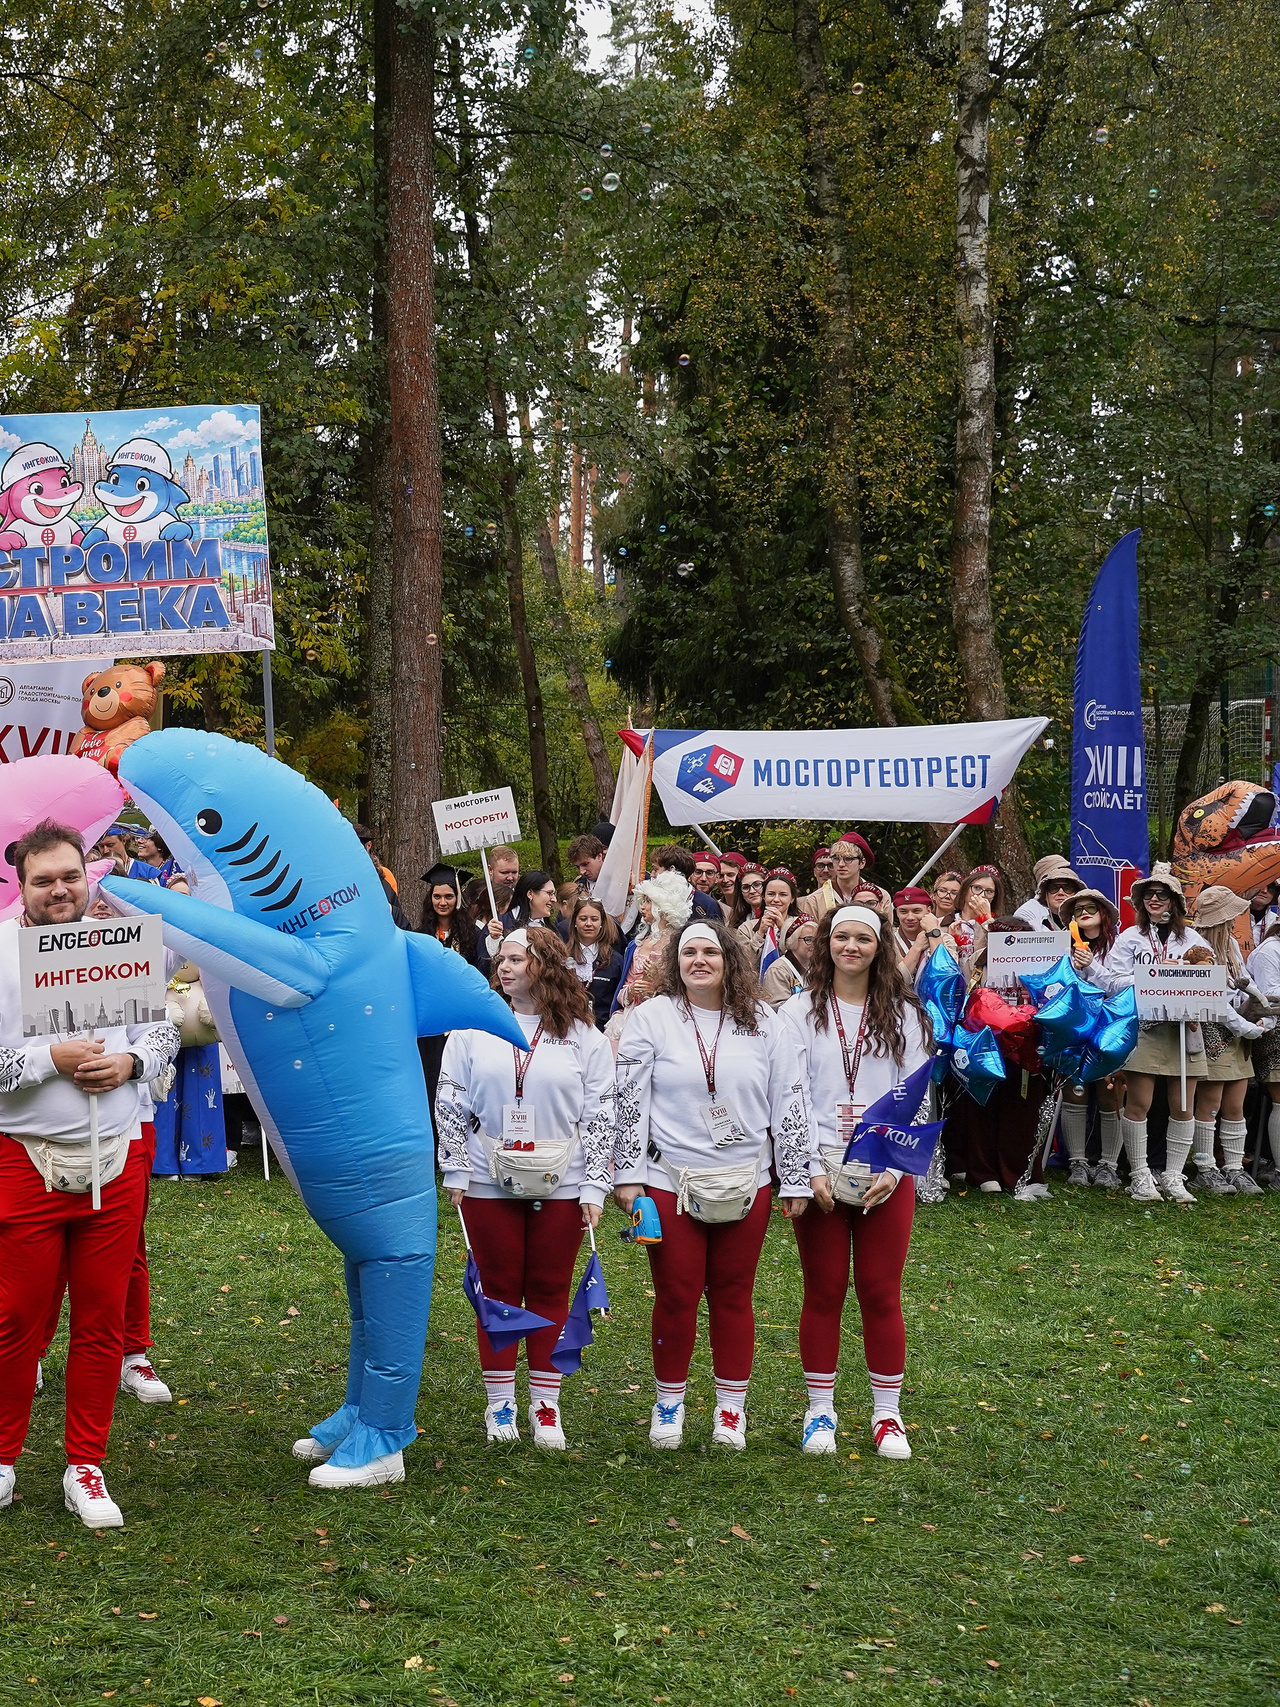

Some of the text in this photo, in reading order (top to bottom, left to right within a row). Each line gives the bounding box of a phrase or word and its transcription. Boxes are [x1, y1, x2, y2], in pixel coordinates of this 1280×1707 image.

[21, 455, 60, 472] ИНГЕОКОМ
[117, 451, 157, 465] ИНГЕОКОМ
[63, 584, 233, 635] ВЕКА
[80, 738, 105, 751] love
[753, 754, 991, 789] МОСГОРГЕОТРЕСТ
[453, 794, 500, 810] МОСГОРБТИ
[444, 811, 509, 831] МОСГОРБТИ
[38, 925, 142, 953] ENGEOCOM
[992, 955, 1062, 963] МОСГОРГЕОТРЕС
[34, 961, 150, 988] ИНГЕОКОМ
[1158, 969, 1211, 978] МОСИНЖПРОЕКТ
[1140, 989, 1224, 997] МОСИНЖПРОЕКТ
